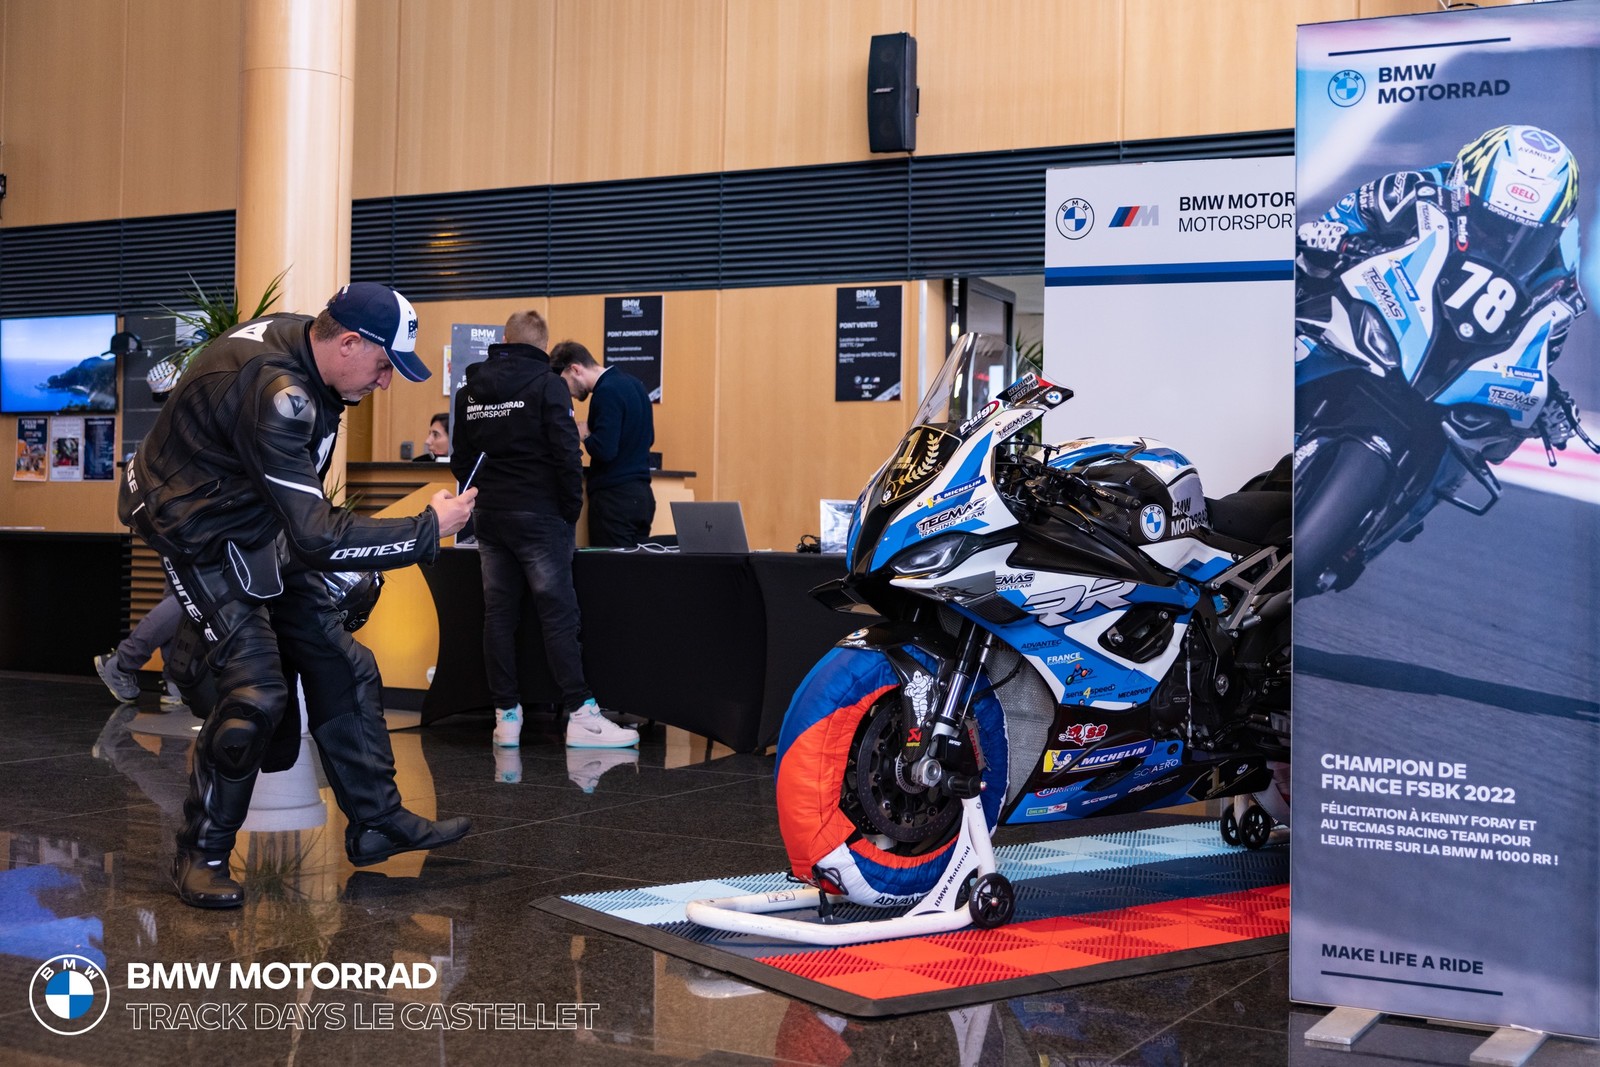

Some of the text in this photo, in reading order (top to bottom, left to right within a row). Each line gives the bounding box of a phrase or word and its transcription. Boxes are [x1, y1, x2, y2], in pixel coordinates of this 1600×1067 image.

[1378, 63, 1436, 83] BMW
[1378, 79, 1510, 104] MOTORRAD
[1518, 146, 1556, 164] AVANISTA
[1180, 195, 1225, 211] BMW
[1510, 186, 1535, 201] BELL
[1178, 213, 1295, 232] MOTORSPOR
[1457, 216, 1468, 243] Puig
[856, 290, 876, 298] BMW
[1368, 267, 1402, 318] TECMAS
[622, 299, 640, 307] BMW
[471, 329, 495, 337] BMW
[467, 401, 524, 413] BMW MOTORRAD
[1491, 388, 1539, 406] TECMAS
[466, 409, 511, 421] MOTORSPORT
[960, 406, 991, 434] Puig
[996, 410, 1033, 437] TECMAS
[944, 480, 981, 498] MICHELIN
[919, 497, 986, 531] TECMAS
[1171, 497, 1191, 516] BMW
[922, 510, 985, 537] RACING TEAM
[330, 539, 417, 560] DAINESE
[1021, 578, 1138, 627] RR
[1021, 639, 1062, 649] ADVANTEC
[1047, 652, 1080, 663] FRANCE
[1080, 746, 1147, 766] MICHELIN
[1321, 753, 1466, 779] CHAMPION DE
[1321, 774, 1515, 804] FRANCE FSBK 2022
[1321, 800, 1537, 831] FÉLICITATION À KENNY FORAY ET
[1321, 818, 1531, 847] AU TECMAS RACING TEAM POUR
[1321, 834, 1558, 865] LEUR TITRE SUR LA BMW M 1000 RR !
[934, 846, 971, 907] BMW Motorrad
[1322, 944, 1483, 974] MAKE LIFE A RIDE
